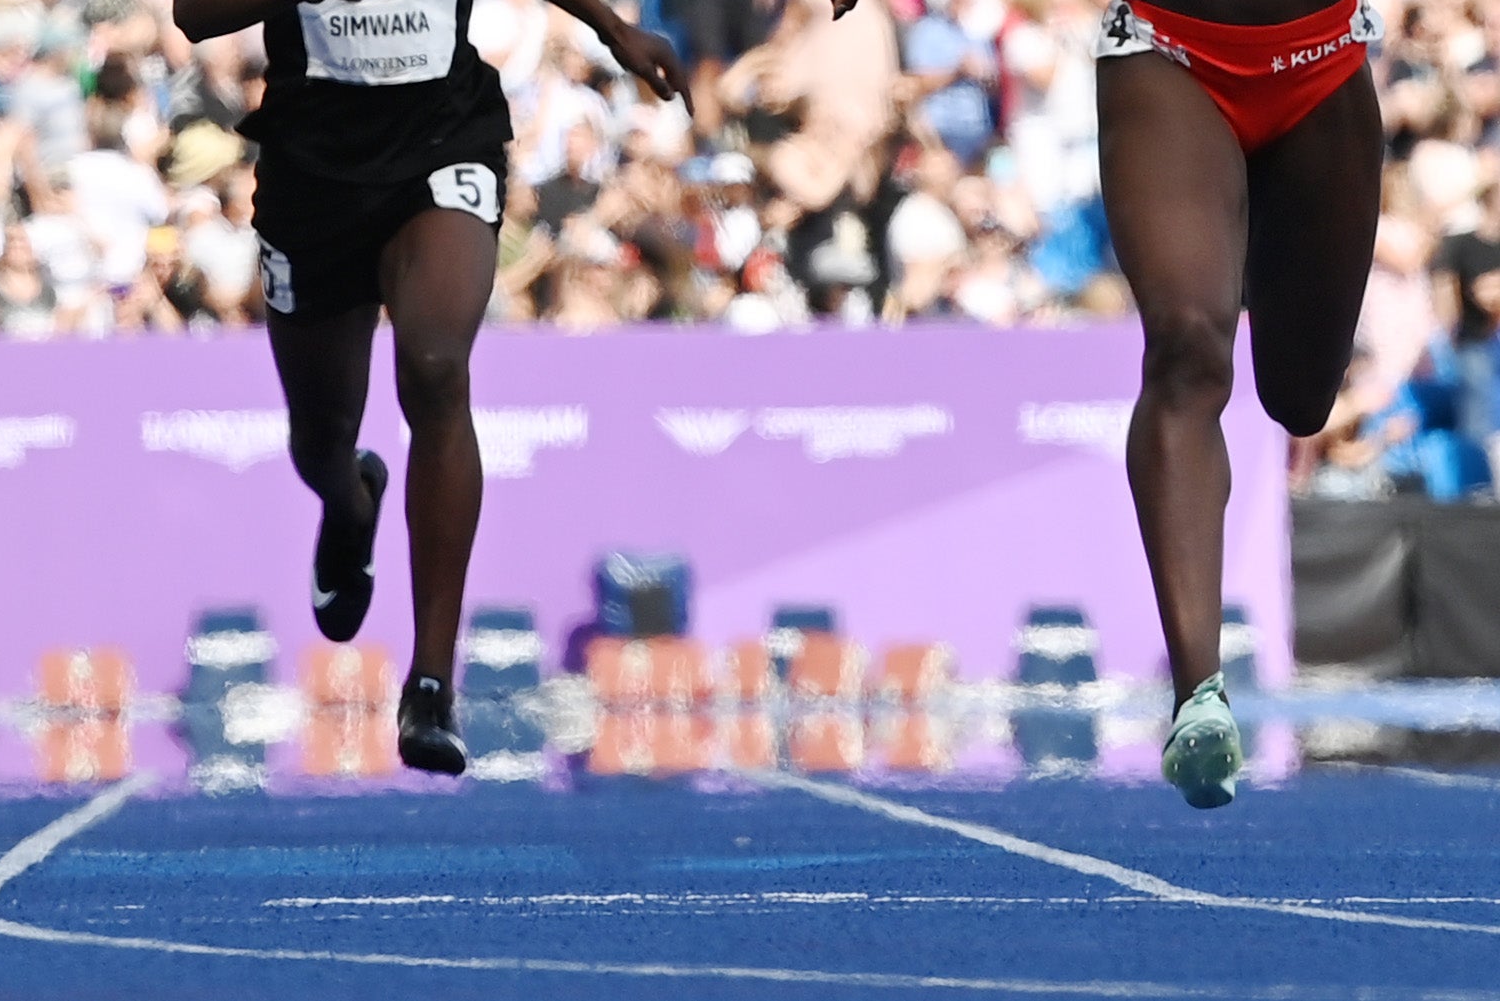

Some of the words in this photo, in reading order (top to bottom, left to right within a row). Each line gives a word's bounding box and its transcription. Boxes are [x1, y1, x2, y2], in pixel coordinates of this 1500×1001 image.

[329, 10, 430, 36] SIMWAKA
[1107, 4, 1133, 47] 4
[340, 54, 428, 71] LONGINES
[1291, 33, 1352, 68] KUKR
[455, 168, 481, 207] 5
